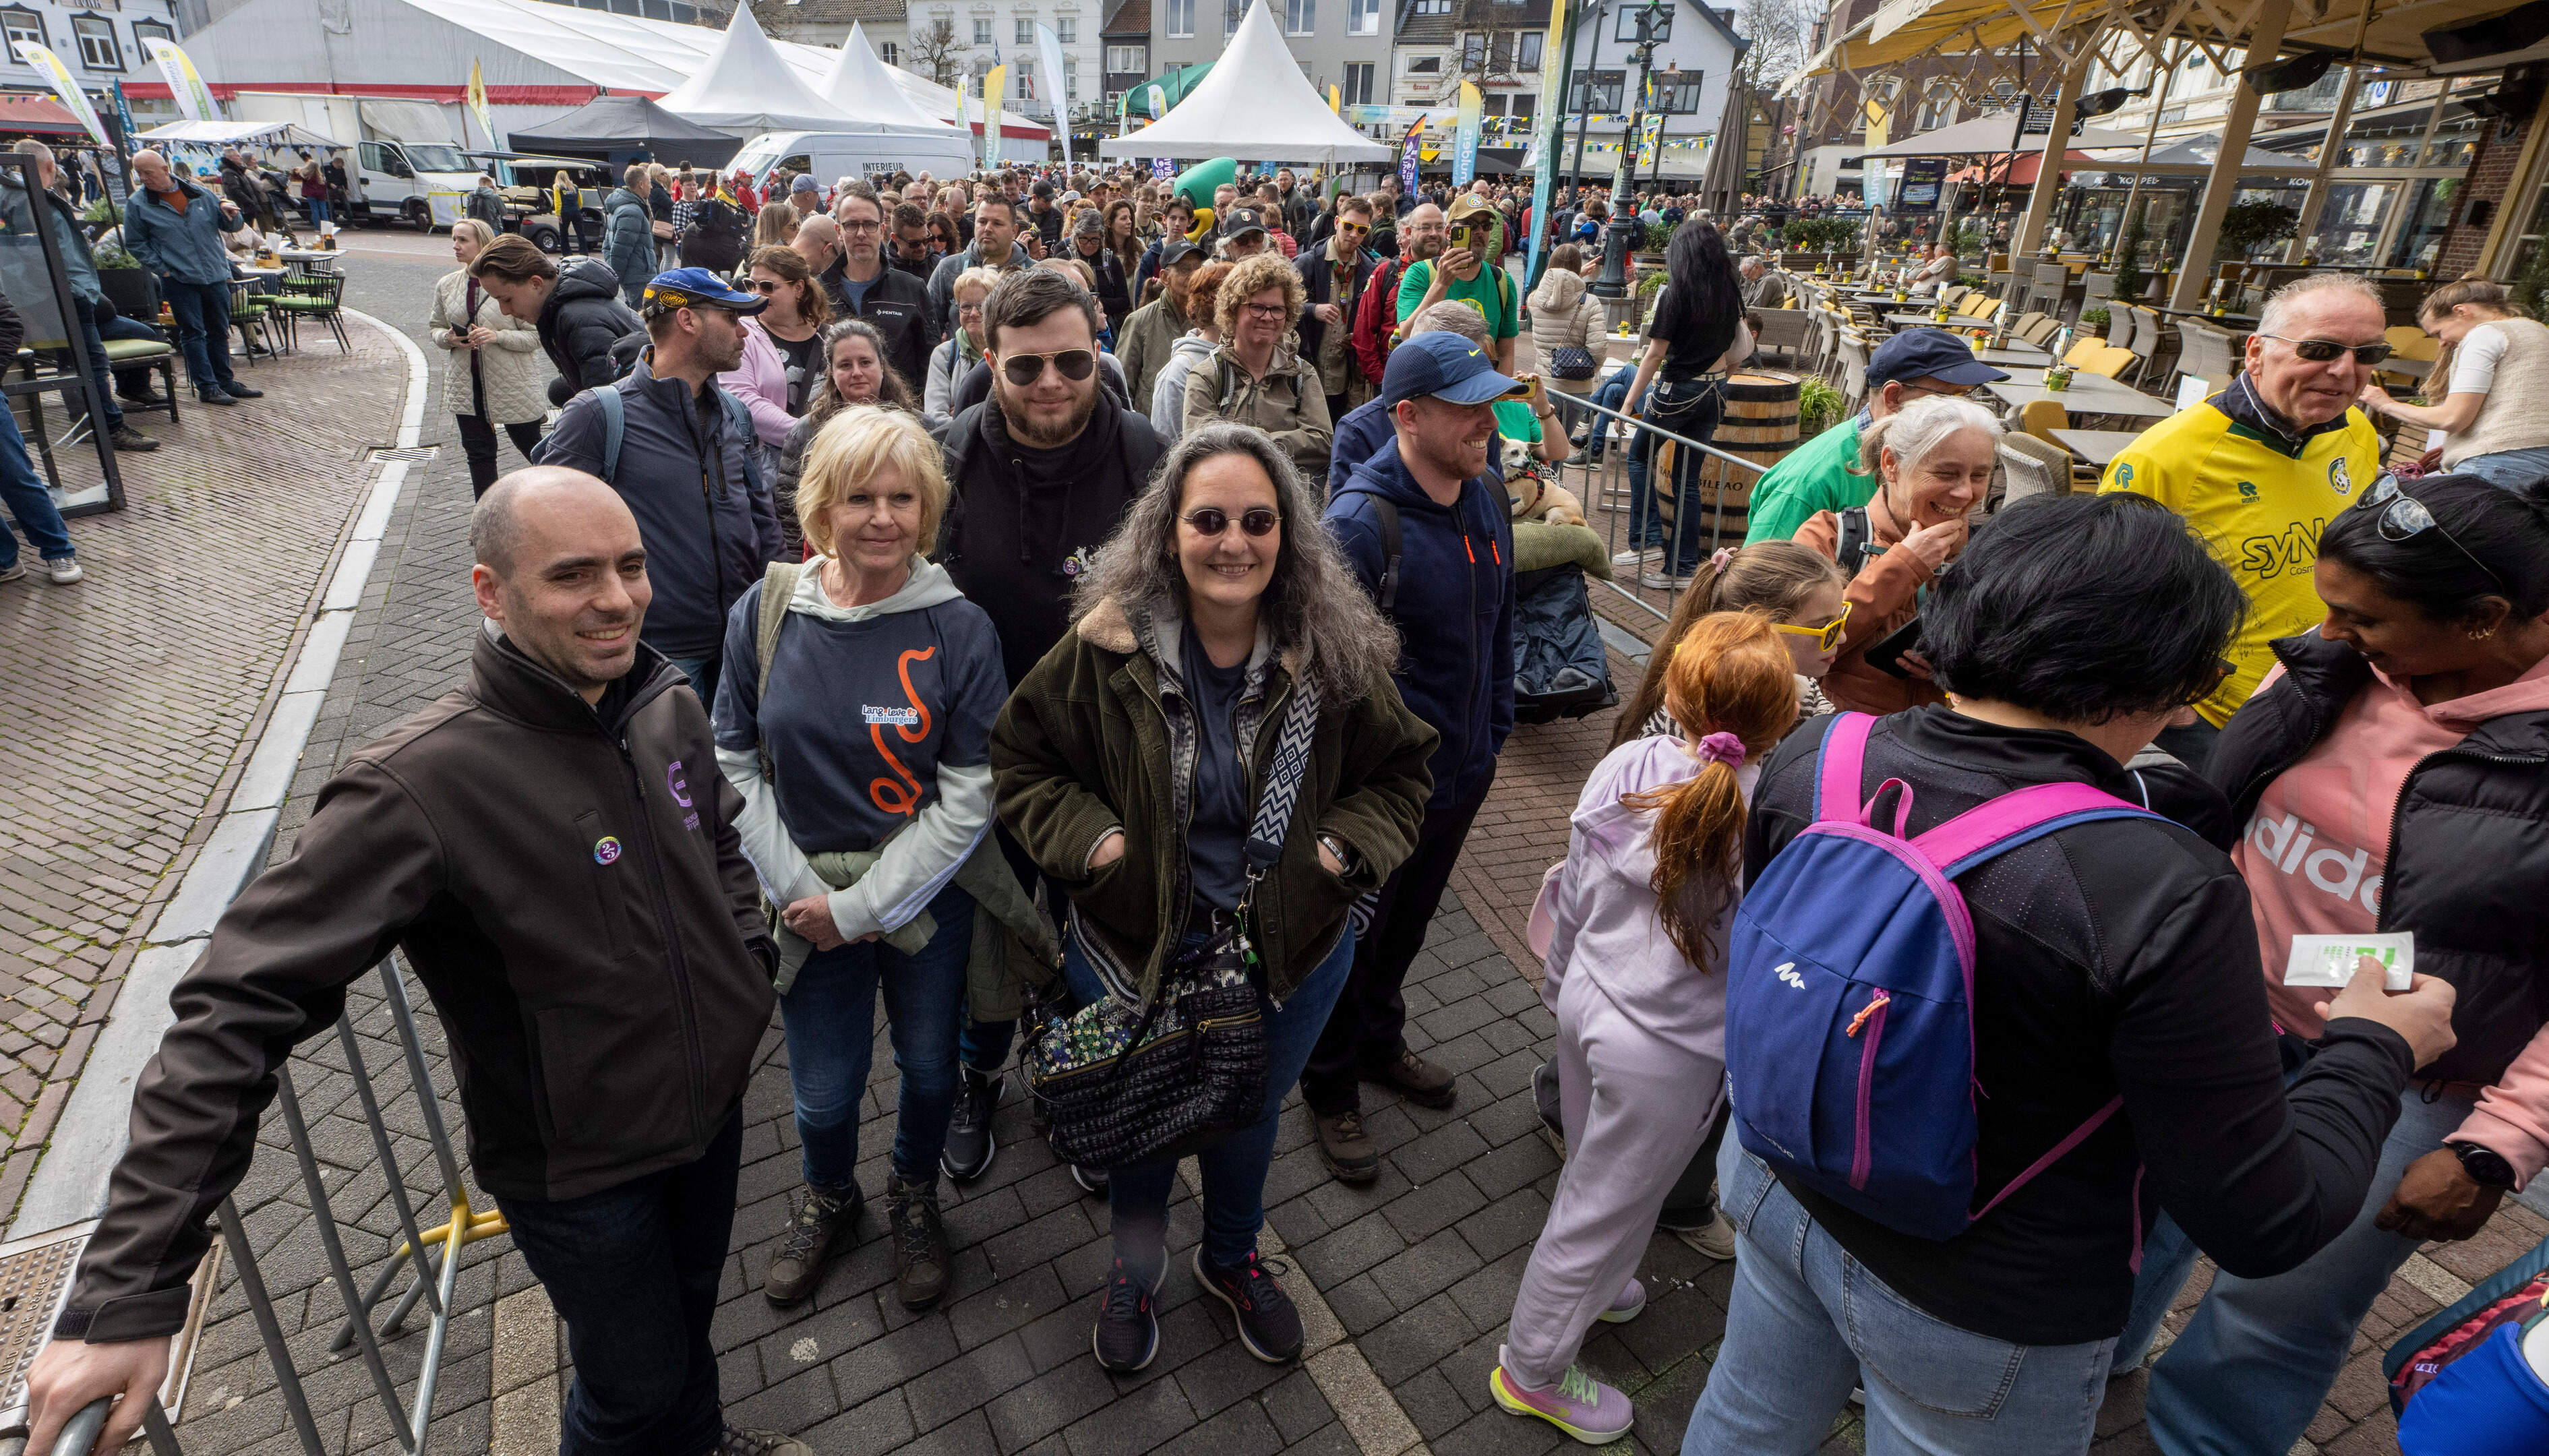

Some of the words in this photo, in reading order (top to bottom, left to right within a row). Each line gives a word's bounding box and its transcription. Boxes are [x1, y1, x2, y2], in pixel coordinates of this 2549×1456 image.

[863, 162, 903, 172] INTERIEUR
[2119, 177, 2157, 185] KOPEL
[2242, 496, 2260, 504] ROBEY
[1067, 560, 1076, 572] 25
[864, 705, 884, 717] Lang
[867, 715, 917, 725] Limburgers
[602, 843, 616, 858] 25
